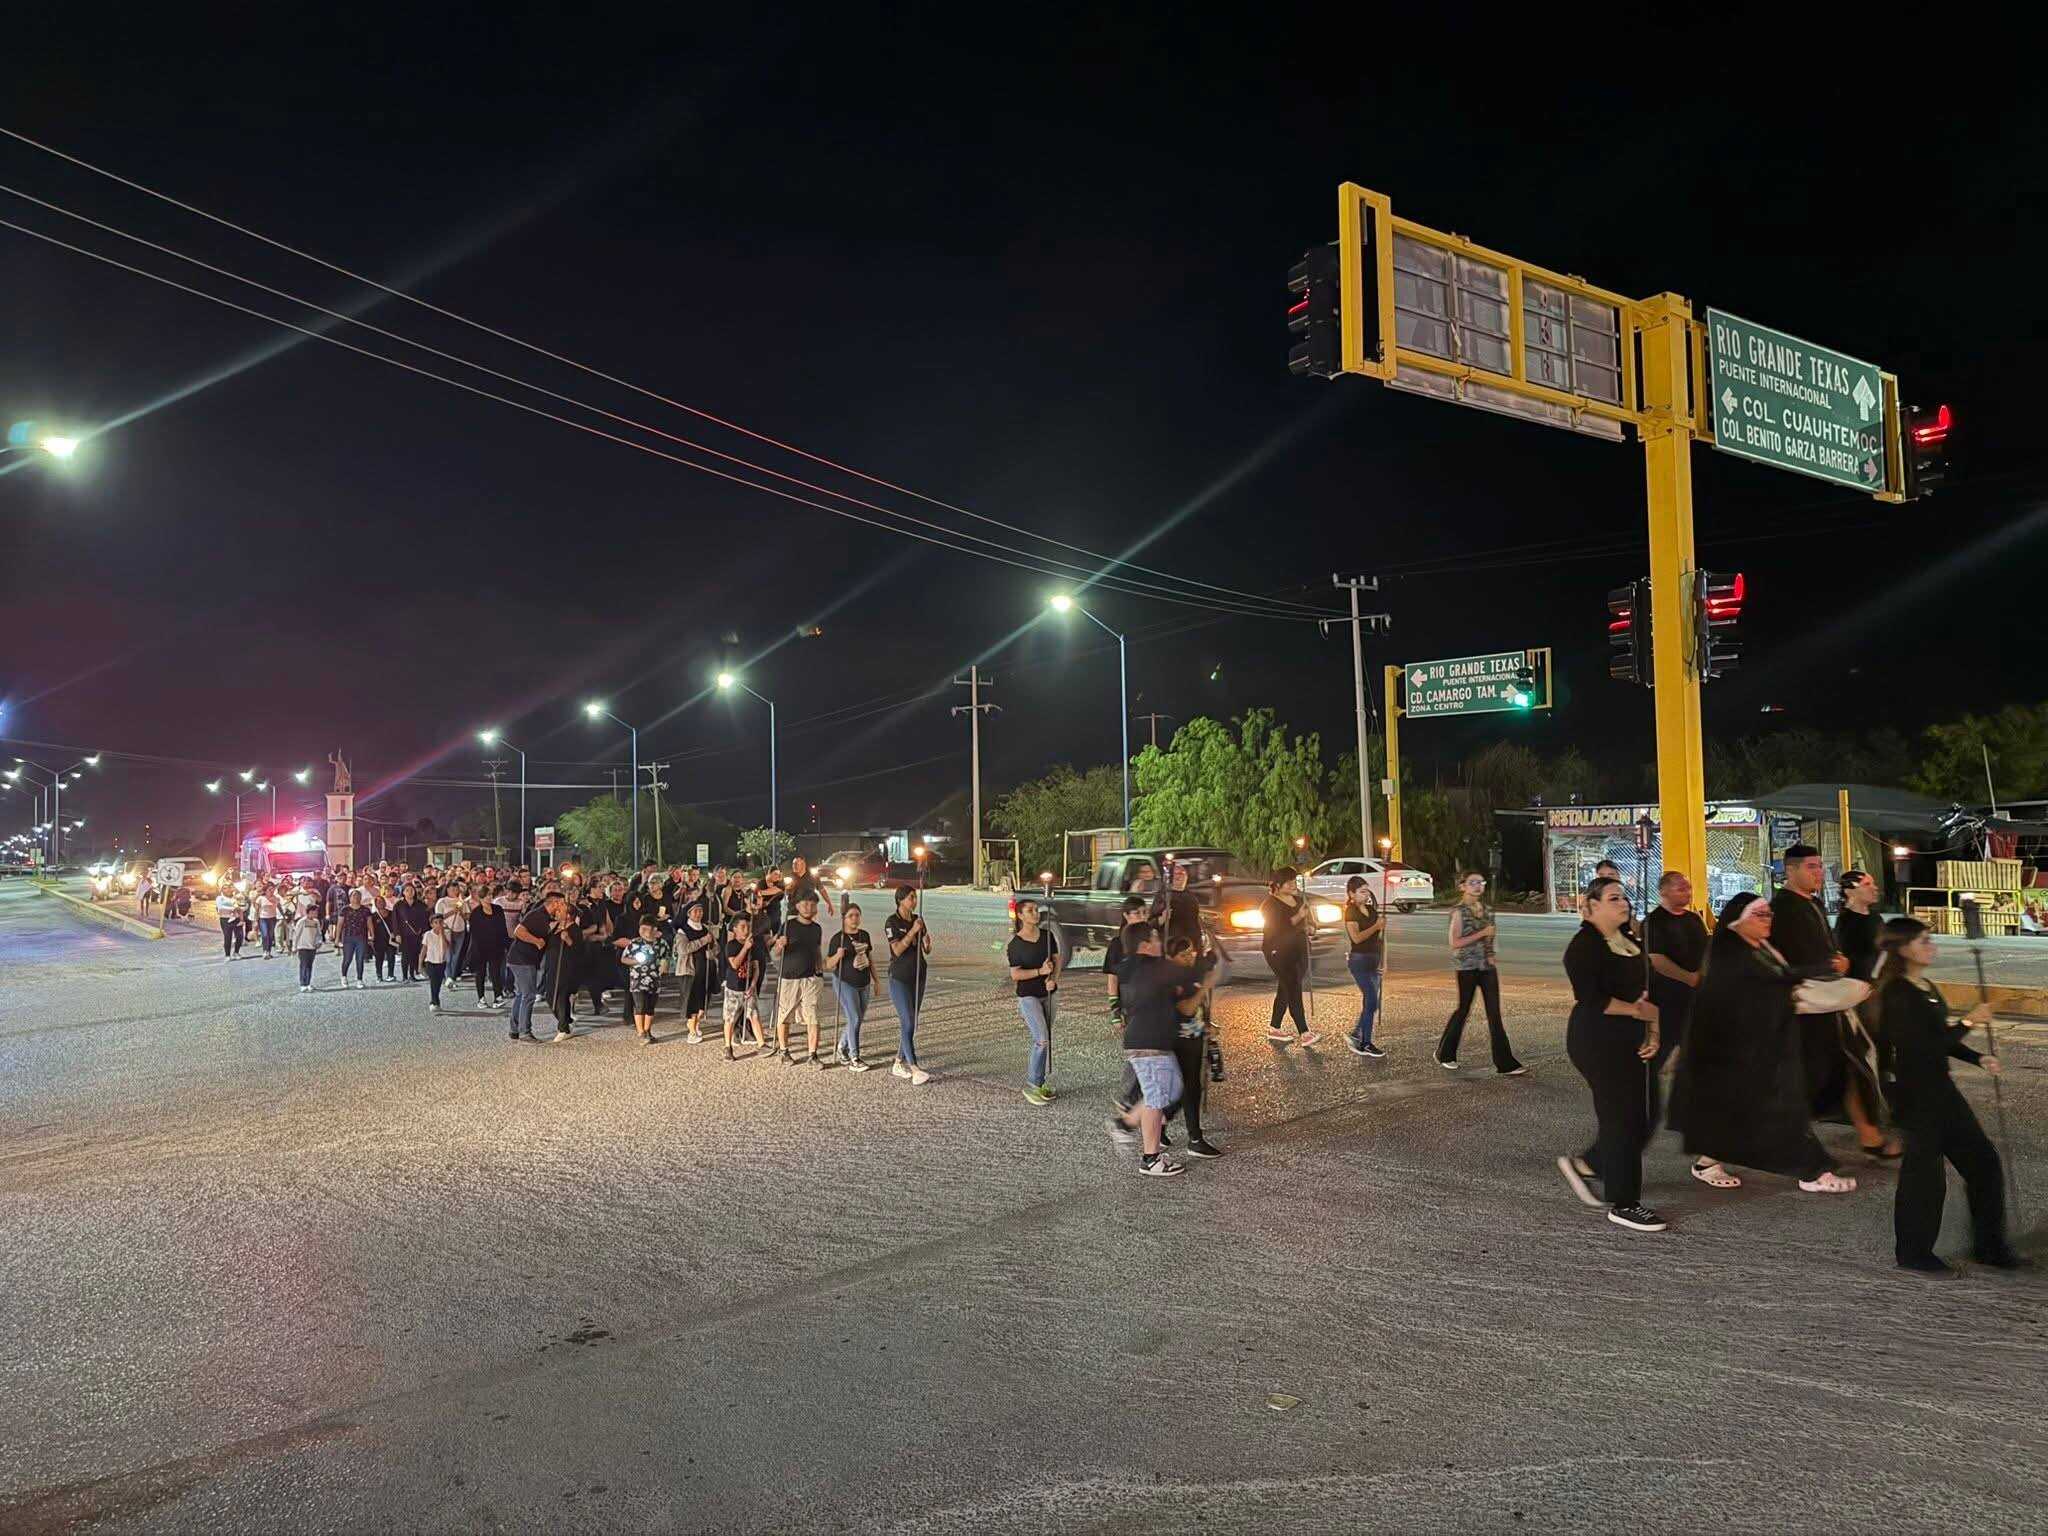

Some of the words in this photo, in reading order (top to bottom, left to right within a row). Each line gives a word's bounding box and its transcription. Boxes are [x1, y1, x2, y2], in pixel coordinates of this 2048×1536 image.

[1716, 324, 1741, 359] RIO
[1749, 336, 1803, 380] GRANDE
[1810, 356, 1849, 395] TEXAS
[1719, 359, 1758, 385] PUENTE
[1760, 371, 1832, 410] INTERNACIONAL
[1743, 397, 1776, 424] COL.
[1783, 409, 1878, 455] CUAUHTEMOC
[1747, 424, 1781, 453] BENITO
[1785, 436, 1817, 462] GARZA
[1819, 446, 1860, 475] BARRERA
[1430, 666, 1444, 679] RIO
[1449, 661, 1485, 676] GRANDE
[1490, 657, 1520, 672] TEXAS
[1443, 677, 1467, 686] PUENTE
[1469, 673, 1518, 683] INTERNACIONAL
[1410, 692, 1425, 705] CD.
[1427, 687, 1472, 703] CAMARGO
[1476, 685, 1497, 698] TAM.
[1411, 705, 1432, 713] ZONA
[1434, 702, 1464, 711] CENTRO
